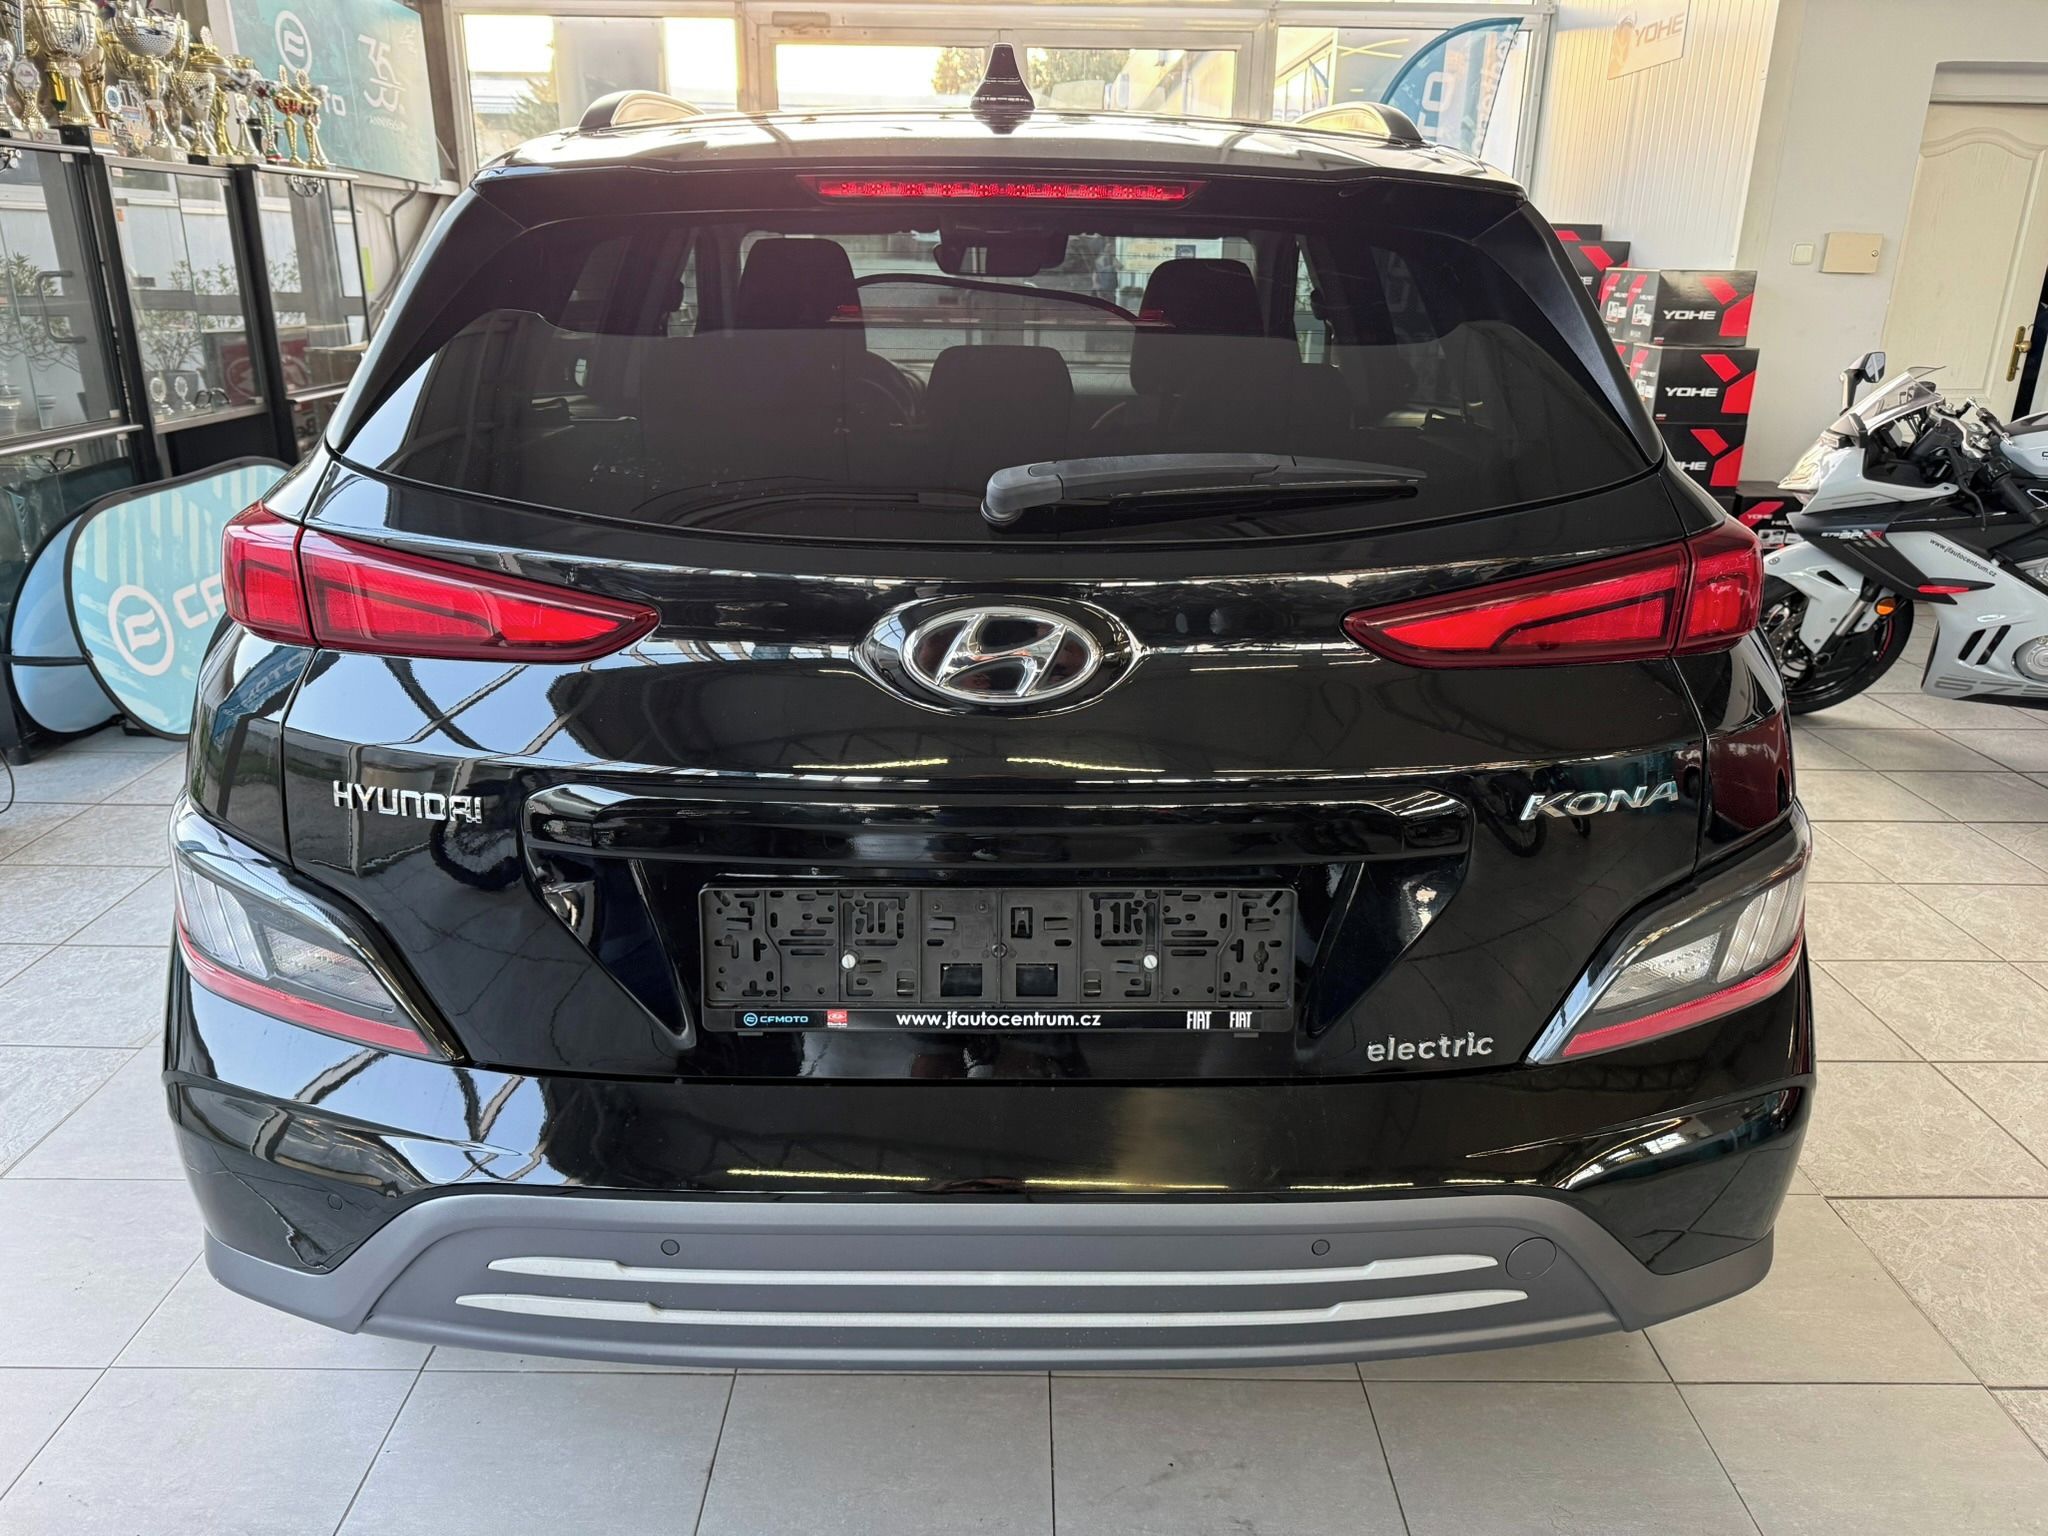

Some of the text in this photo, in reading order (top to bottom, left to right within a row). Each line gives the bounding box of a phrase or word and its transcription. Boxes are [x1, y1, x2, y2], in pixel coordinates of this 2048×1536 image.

[1635, 12, 1685, 47] YOHE
[1663, 310, 1717, 320] YOHE
[1665, 387, 1719, 397] YOHE
[1929, 539, 1998, 578] www.jfautocentrum.cz
[333, 780, 483, 824] HYUNDAI
[1520, 780, 1679, 821] KONA
[760, 1015, 809, 1023] CFMOTO
[896, 1011, 1101, 1029] www.jfautocentrum.cz
[1186, 1011, 1212, 1029] FIAT
[1229, 1011, 1253, 1028] FIAT
[1367, 1031, 1494, 1062] electric
